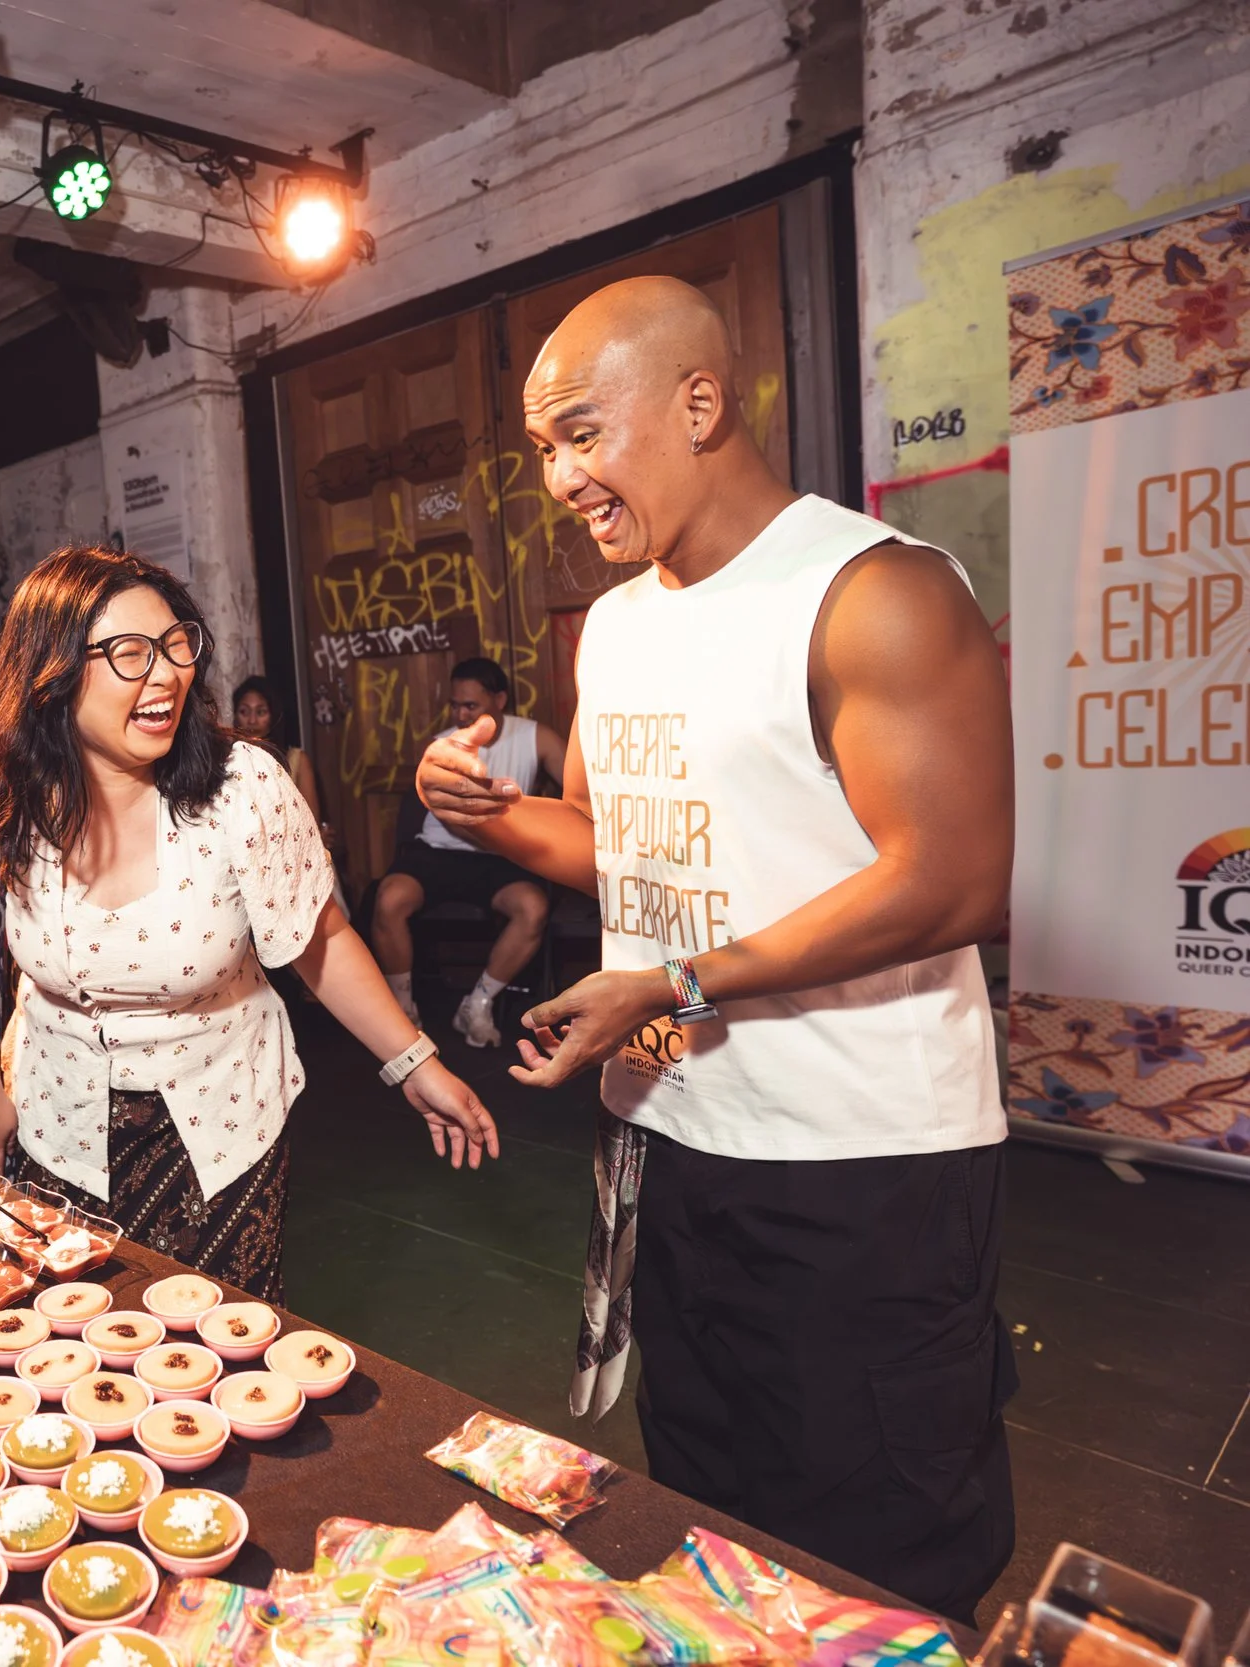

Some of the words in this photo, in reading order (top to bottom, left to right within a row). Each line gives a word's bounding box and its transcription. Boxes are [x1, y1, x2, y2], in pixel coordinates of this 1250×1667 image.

[1077, 683, 1250, 769] CELE
[597, 713, 687, 780] CREATE
[1176, 944, 1250, 963] INDO
[1177, 962, 1234, 976] QUEER
[626, 1055, 685, 1084] INDONESIAN
[626, 1068, 650, 1081] QUEER
[651, 1073, 685, 1093] COLLECTIVE
